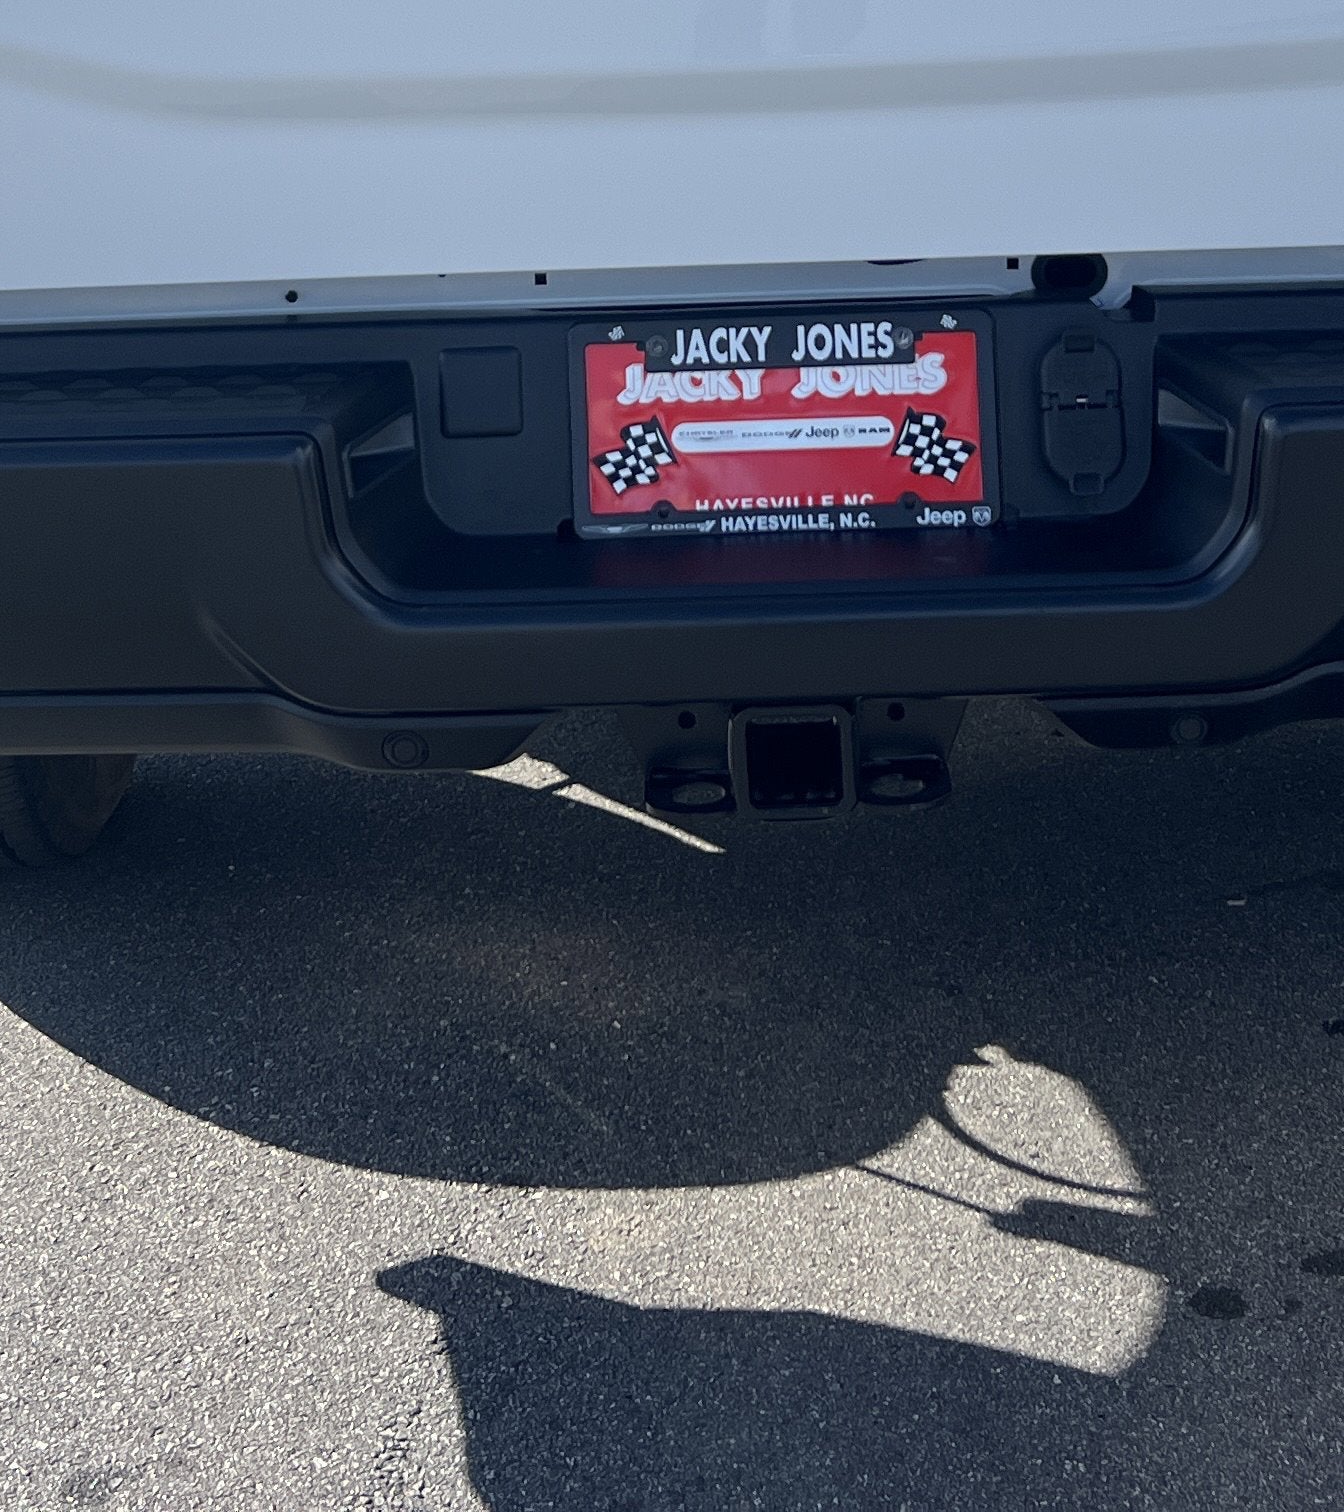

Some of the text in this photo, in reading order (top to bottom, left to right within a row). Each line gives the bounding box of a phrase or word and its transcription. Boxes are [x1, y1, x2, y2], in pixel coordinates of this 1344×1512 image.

[670, 321, 895, 365] JACKY JONES
[617, 352, 949, 405] JACKY JONES
[805, 425, 840, 440] Jeep
[858, 427, 891, 435] RAM
[720, 513, 835, 533] HAYESVILLE,
[839, 512, 877, 529] N.C.
[916, 507, 968, 527] Jeep
